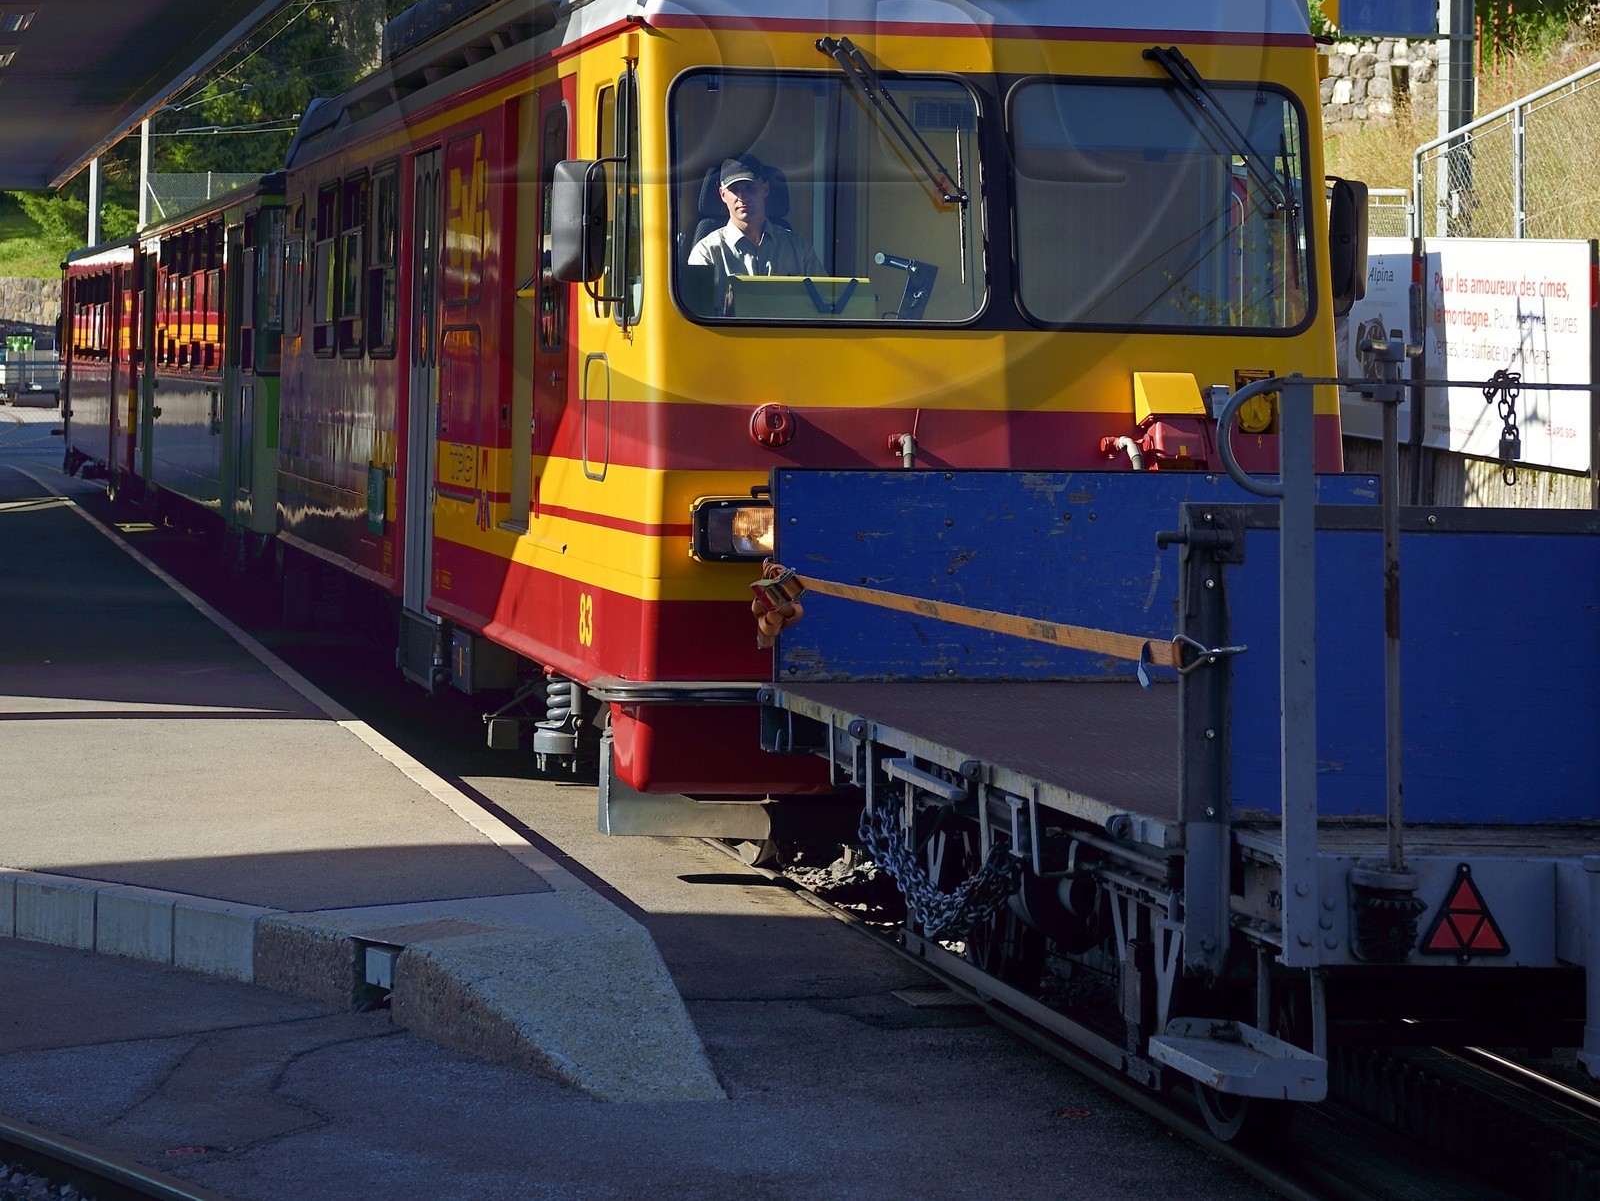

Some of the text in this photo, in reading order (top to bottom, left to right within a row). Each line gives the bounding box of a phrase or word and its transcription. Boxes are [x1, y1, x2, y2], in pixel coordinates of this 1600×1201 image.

[1368, 267, 1394, 285] Alpina
[1434, 272, 1570, 301] Pour les amoureux des cimes,
[1433, 303, 1442, 323] la
[1444, 308, 1492, 332] montagne.
[579, 592, 593, 648] 83
